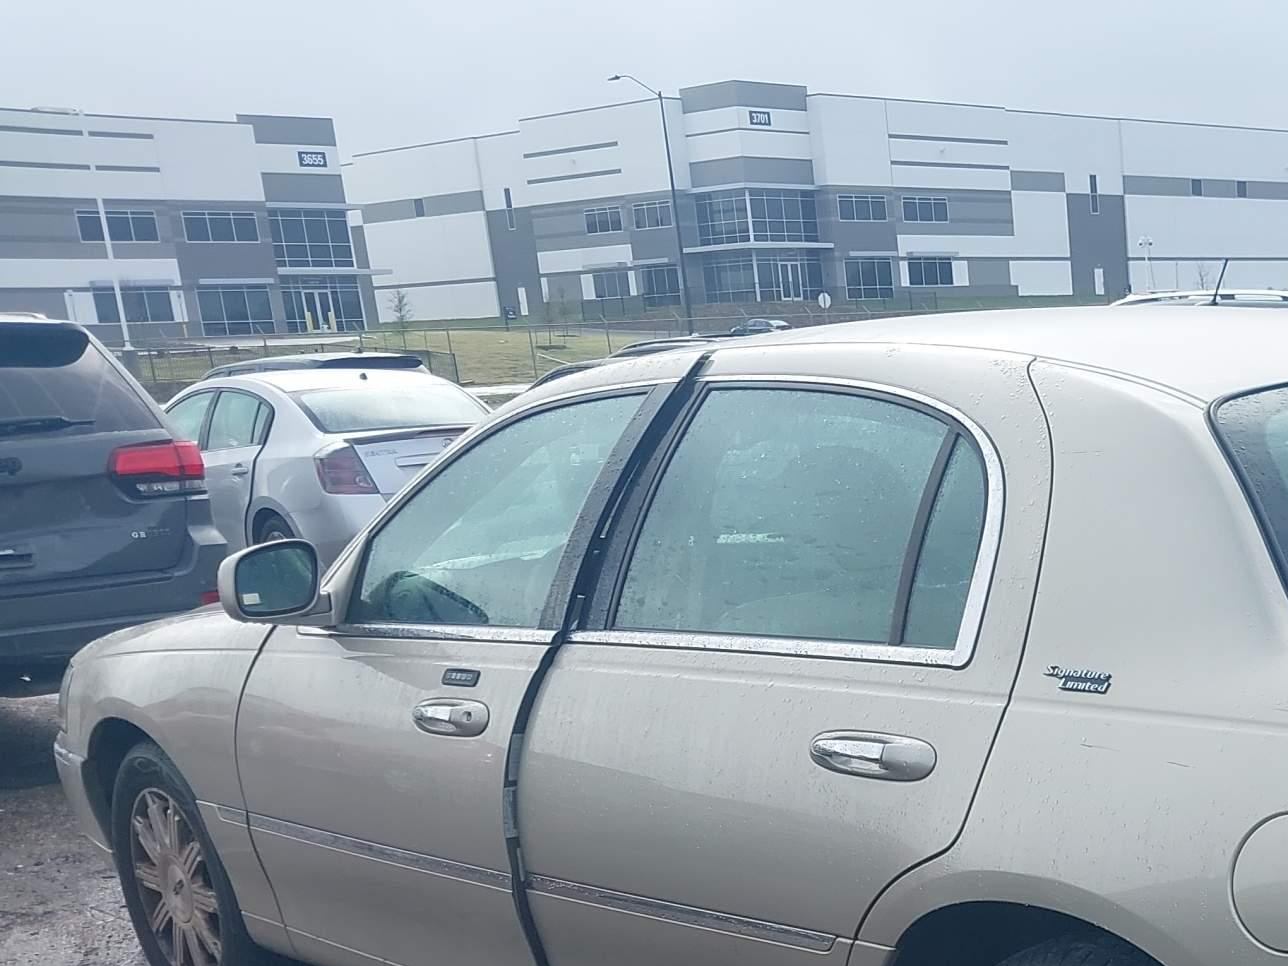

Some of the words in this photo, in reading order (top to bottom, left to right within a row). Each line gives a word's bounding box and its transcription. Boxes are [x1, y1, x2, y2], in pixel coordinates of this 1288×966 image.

[752, 112, 768, 124] 3701
[301, 153, 324, 165] 3655
[1045, 665, 1111, 680] Signature
[1058, 677, 1111, 694] Limited
